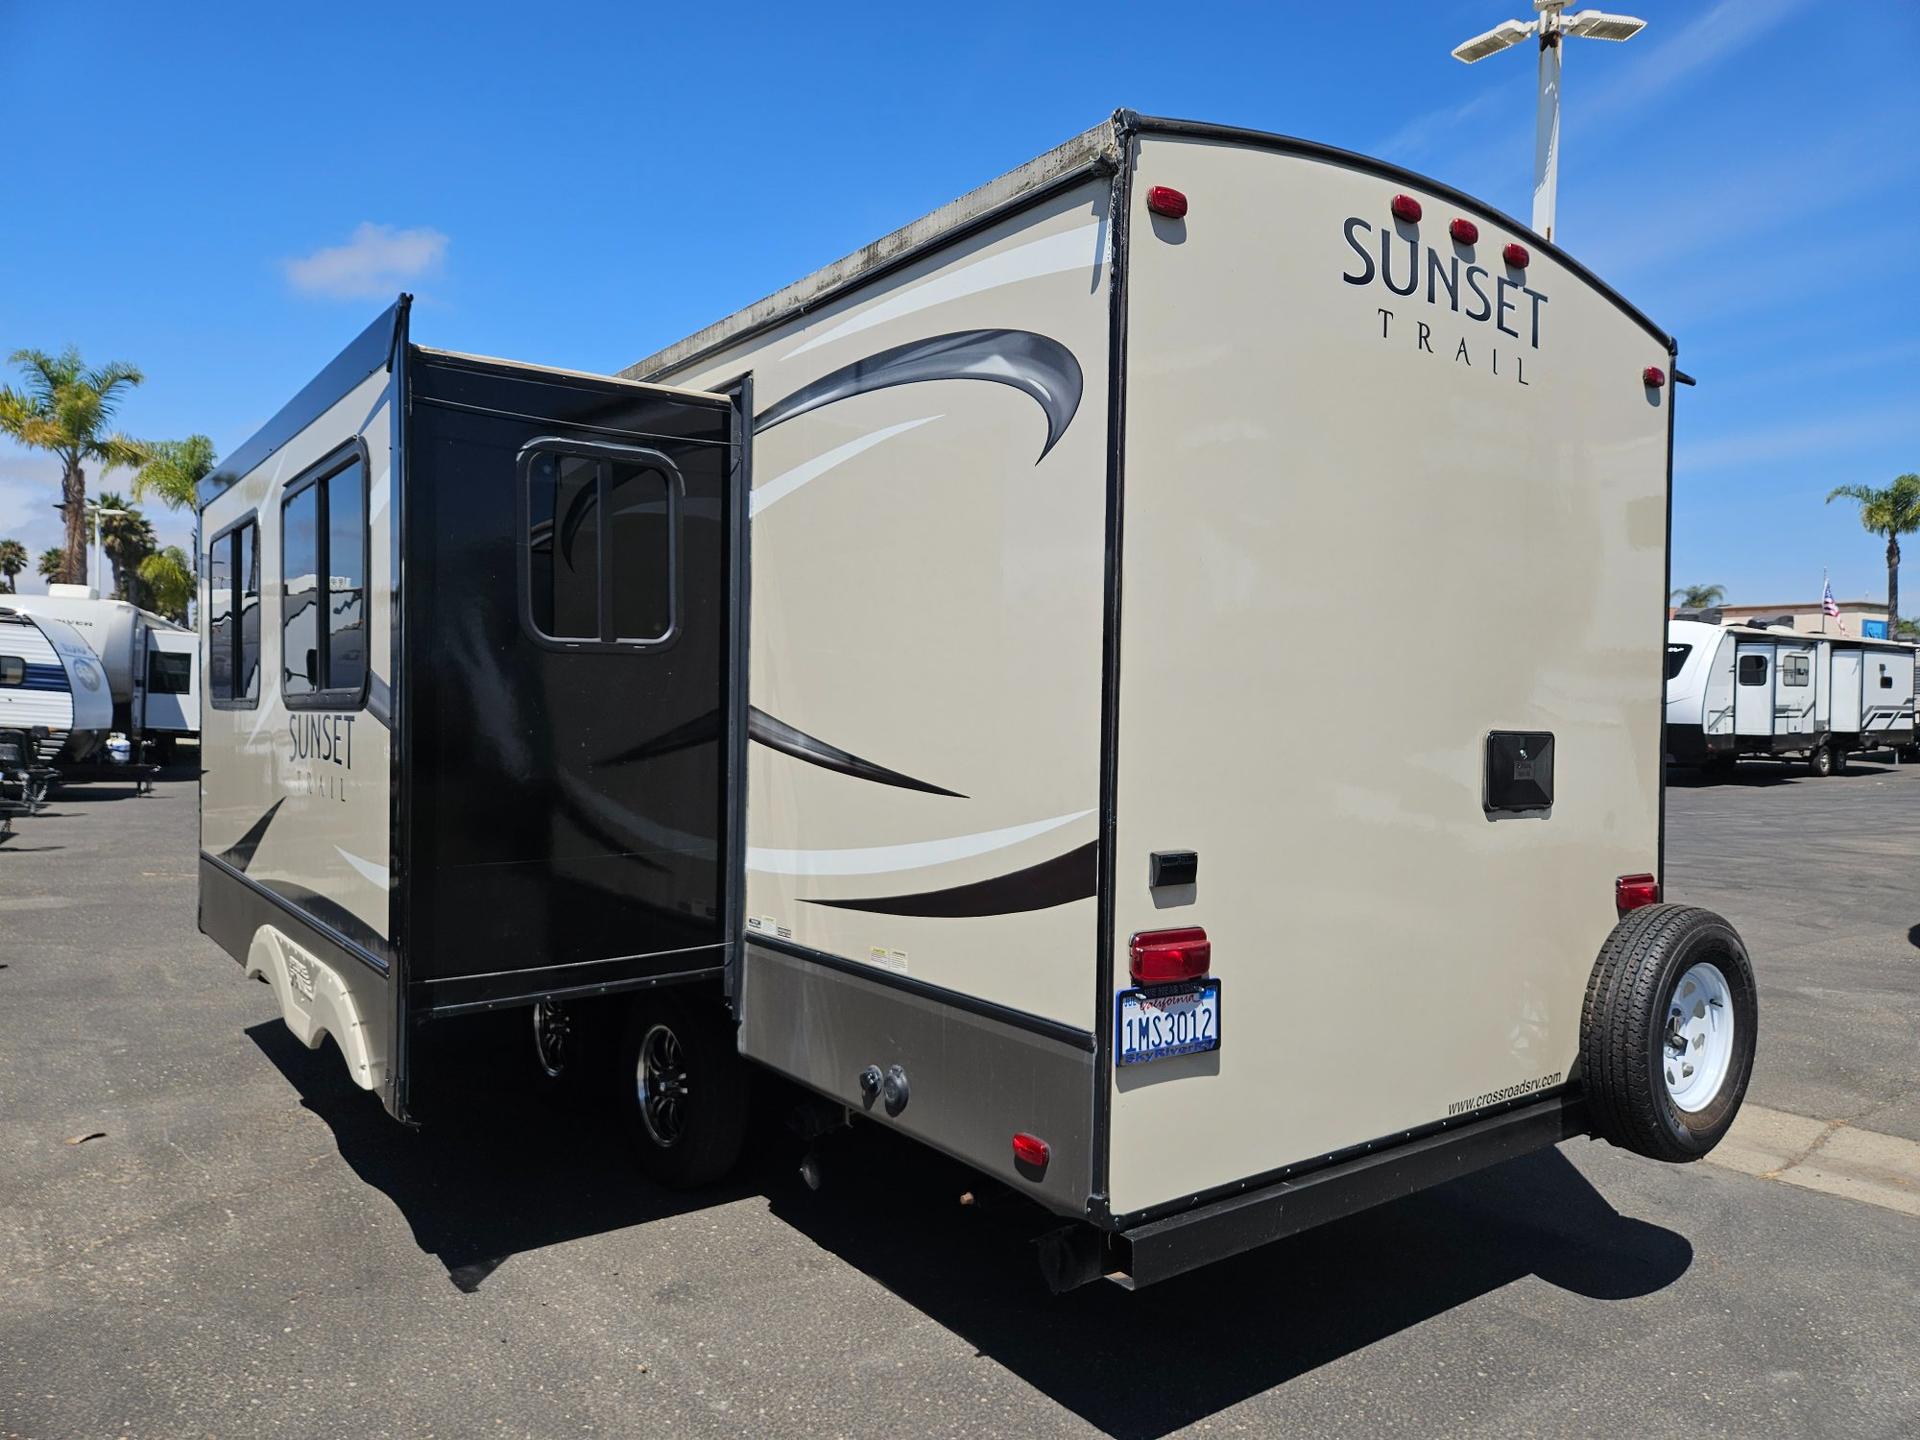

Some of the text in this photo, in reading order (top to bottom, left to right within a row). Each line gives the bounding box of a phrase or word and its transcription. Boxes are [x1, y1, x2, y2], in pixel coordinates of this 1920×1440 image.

[1343, 216, 1549, 350] SUNSET
[1377, 308, 1529, 386] TRAIL
[288, 713, 356, 770] SUNSET
[296, 770, 347, 802] TRAIL
[1126, 1007, 1213, 1053] 1MS3012
[1448, 1071, 1562, 1116] www.crossroadsrv.com
